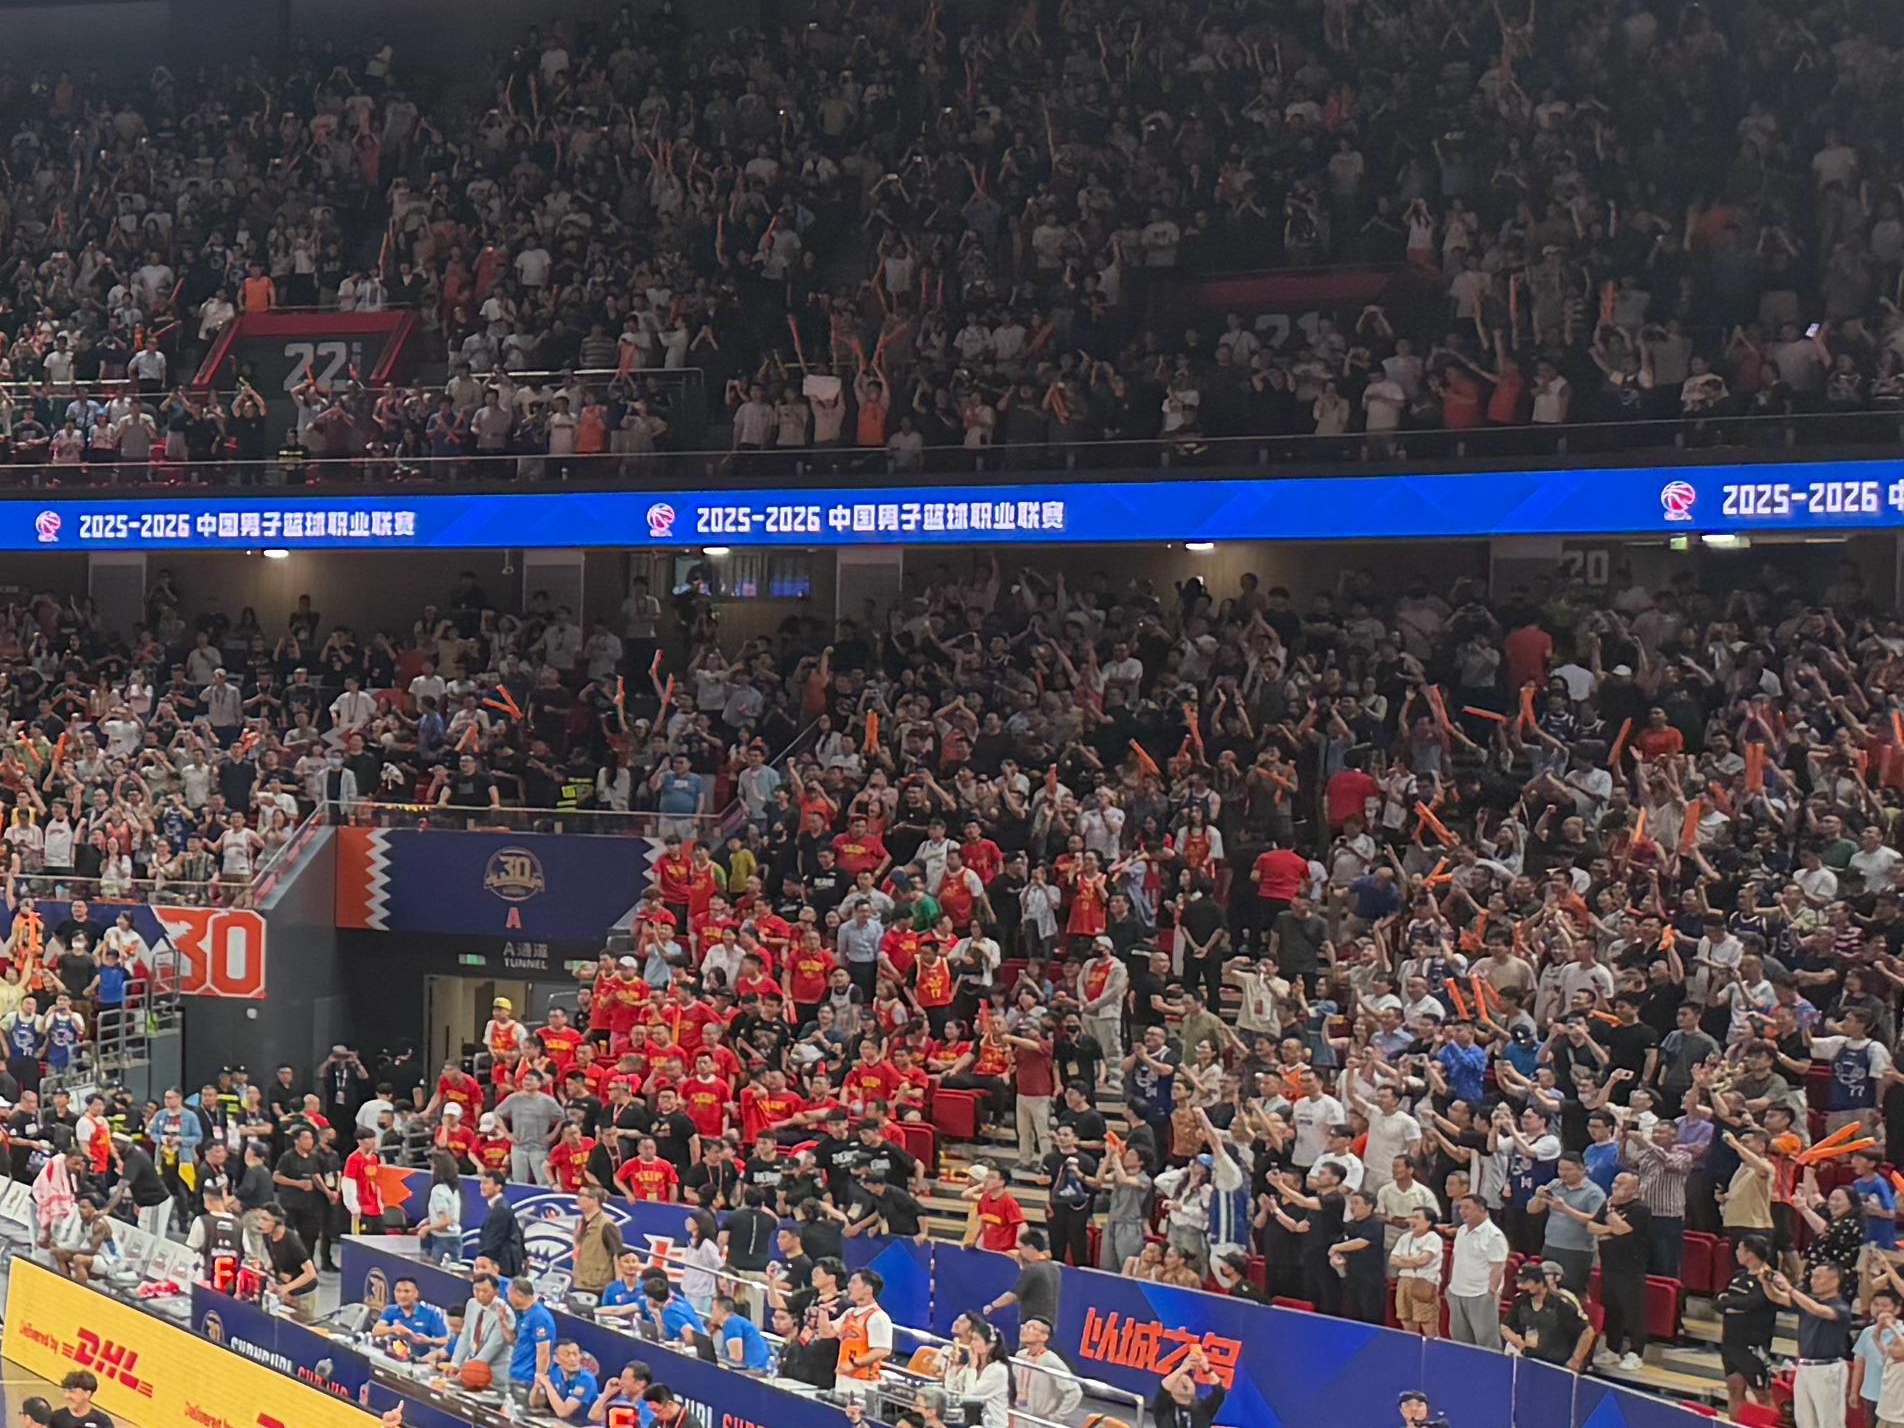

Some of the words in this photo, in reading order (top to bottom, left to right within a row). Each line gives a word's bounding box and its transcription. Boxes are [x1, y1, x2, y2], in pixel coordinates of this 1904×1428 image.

[1722, 481, 1880, 516] 2025-2026
[79, 513, 190, 539] 2025-2026
[196, 511, 415, 538] 中国男子篮球职业联赛
[697, 506, 821, 533] 2025-2026
[828, 501, 1065, 532] 中国男子篮球职业联赛
[505, 907, 522, 929] A
[72, 1326, 141, 1391] DHL
